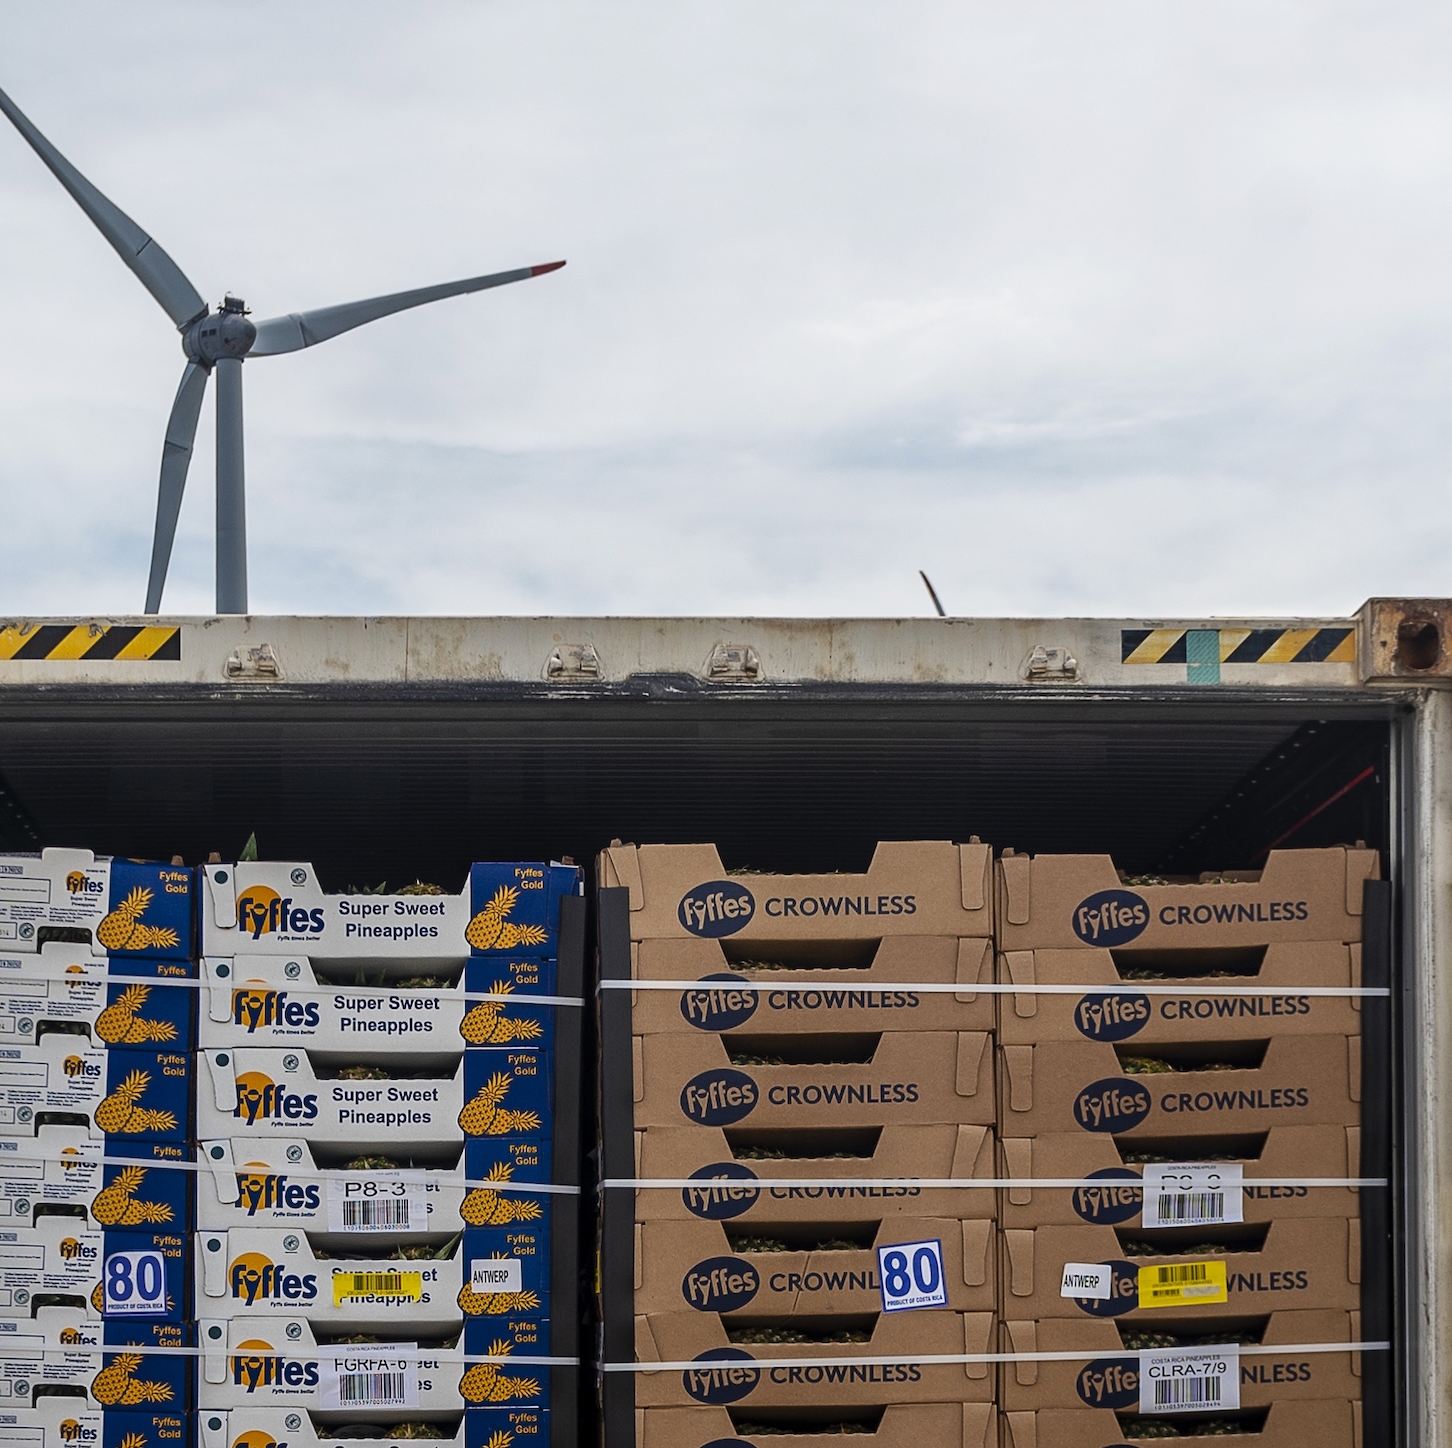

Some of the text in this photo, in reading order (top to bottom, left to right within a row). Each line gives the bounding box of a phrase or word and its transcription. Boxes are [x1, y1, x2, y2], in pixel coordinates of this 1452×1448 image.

[159, 871, 188, 882] Fyffes
[514, 869, 543, 878] Fyffes
[165, 884, 187, 894] Gold
[521, 880, 543, 889] Gold
[339, 901, 445, 918] Super Sweet
[765, 895, 916, 917] CROWNLESS
[1159, 902, 1308, 925] CROWNLESS
[345, 924, 438, 941] Pineapples
[510, 963, 537, 973] Fyffes
[516, 975, 538, 984] Gold
[334, 996, 440, 1013] Super Sweet
[768, 990, 919, 1010] CROWNLESS
[1160, 996, 1310, 1020] CROWNLESS
[340, 1018, 433, 1034] Pineapples
[157, 1055, 186, 1064] Fyffes
[508, 1055, 536, 1065] Fyffes
[163, 1067, 185, 1076] Gold
[514, 1066, 536, 1075] Gold
[332, 1088, 438, 1105] Super Sweet
[768, 1084, 918, 1104] CROWNLESS
[1160, 1088, 1308, 1113] CROWNLESS
[339, 1110, 431, 1125] Pineapples
[153, 1147, 182, 1157] Fyffes
[509, 1145, 537, 1154] Fyffes
[515, 1156, 537, 1165] Gold
[345, 1182, 406, 1197] P8-3
[153, 1236, 182, 1246] Fyffes
[507, 1235, 535, 1244] Fyffes
[513, 1246, 535, 1255] Gold
[473, 1269, 509, 1284] ANTWERP
[884, 1247, 939, 1297] 80
[108, 1256, 162, 1301] 80
[1064, 1275, 1100, 1289] ANTWERP
[153, 1326, 181, 1336] Fyffes
[509, 1322, 536, 1332] Fyffes
[159, 1338, 181, 1347] Gold
[515, 1333, 536, 1343] Gold
[770, 1364, 921, 1383] CROWNLESS
[1149, 1362, 1227, 1378] CLRA-7/9
[152, 1418, 181, 1427] Fyffes
[509, 1413, 537, 1423] Fyffes
[158, 1430, 181, 1439] Gold
[515, 1425, 537, 1434] Gold
